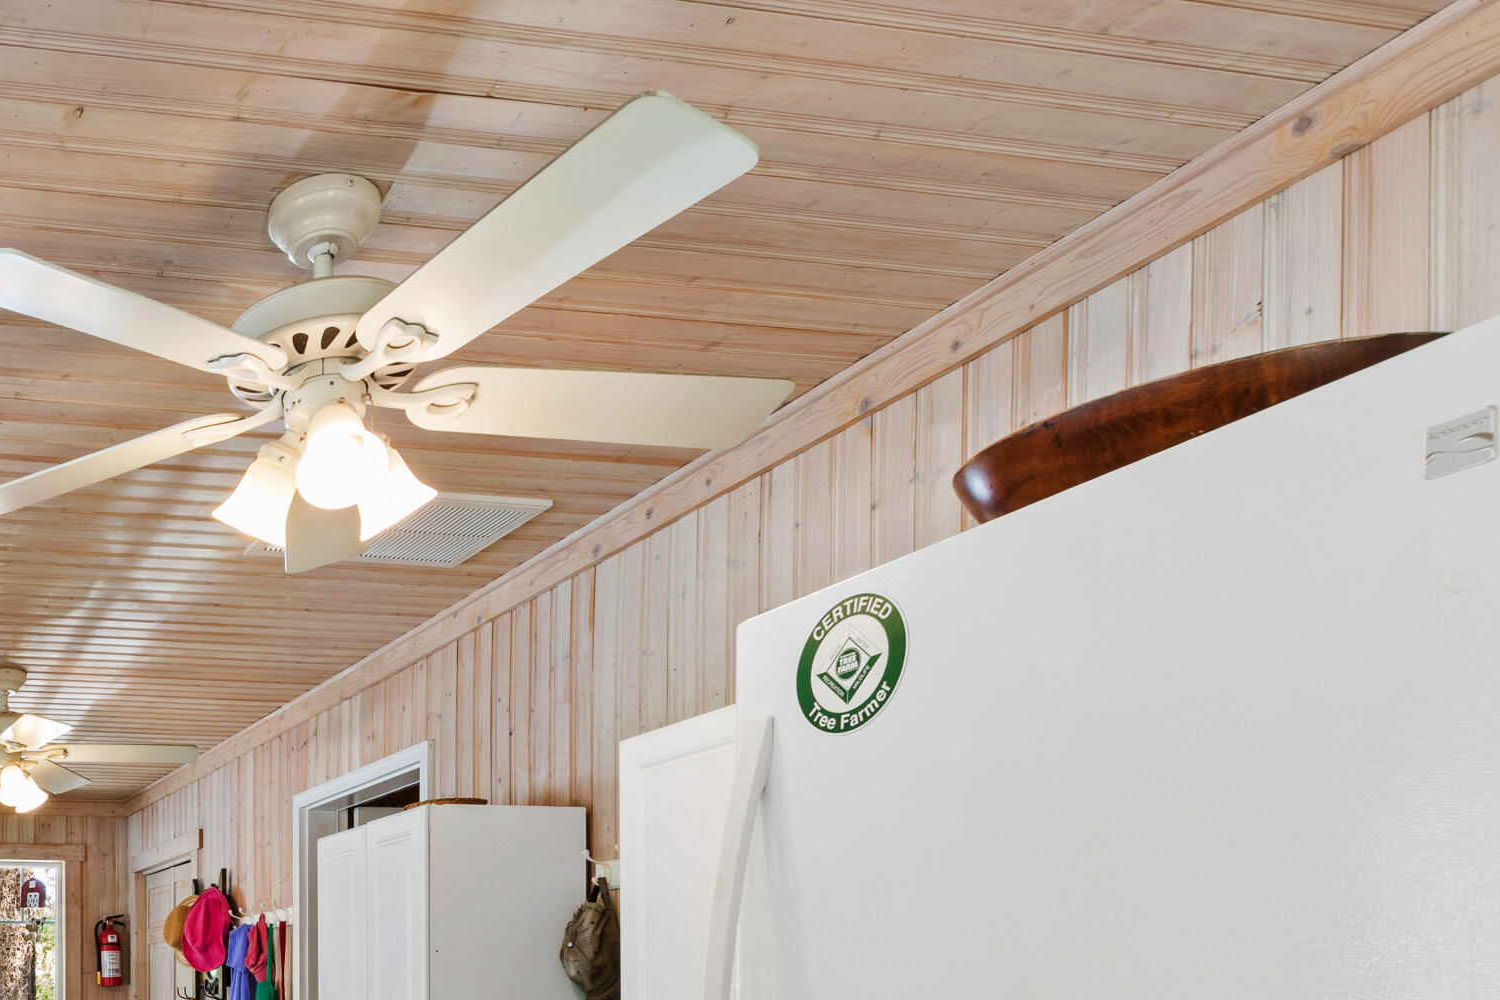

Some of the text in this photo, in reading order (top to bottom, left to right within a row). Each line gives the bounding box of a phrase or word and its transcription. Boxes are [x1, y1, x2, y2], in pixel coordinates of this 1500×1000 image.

[812, 596, 893, 641] CERTIFIED
[808, 681, 891, 730] Tree Farmer
